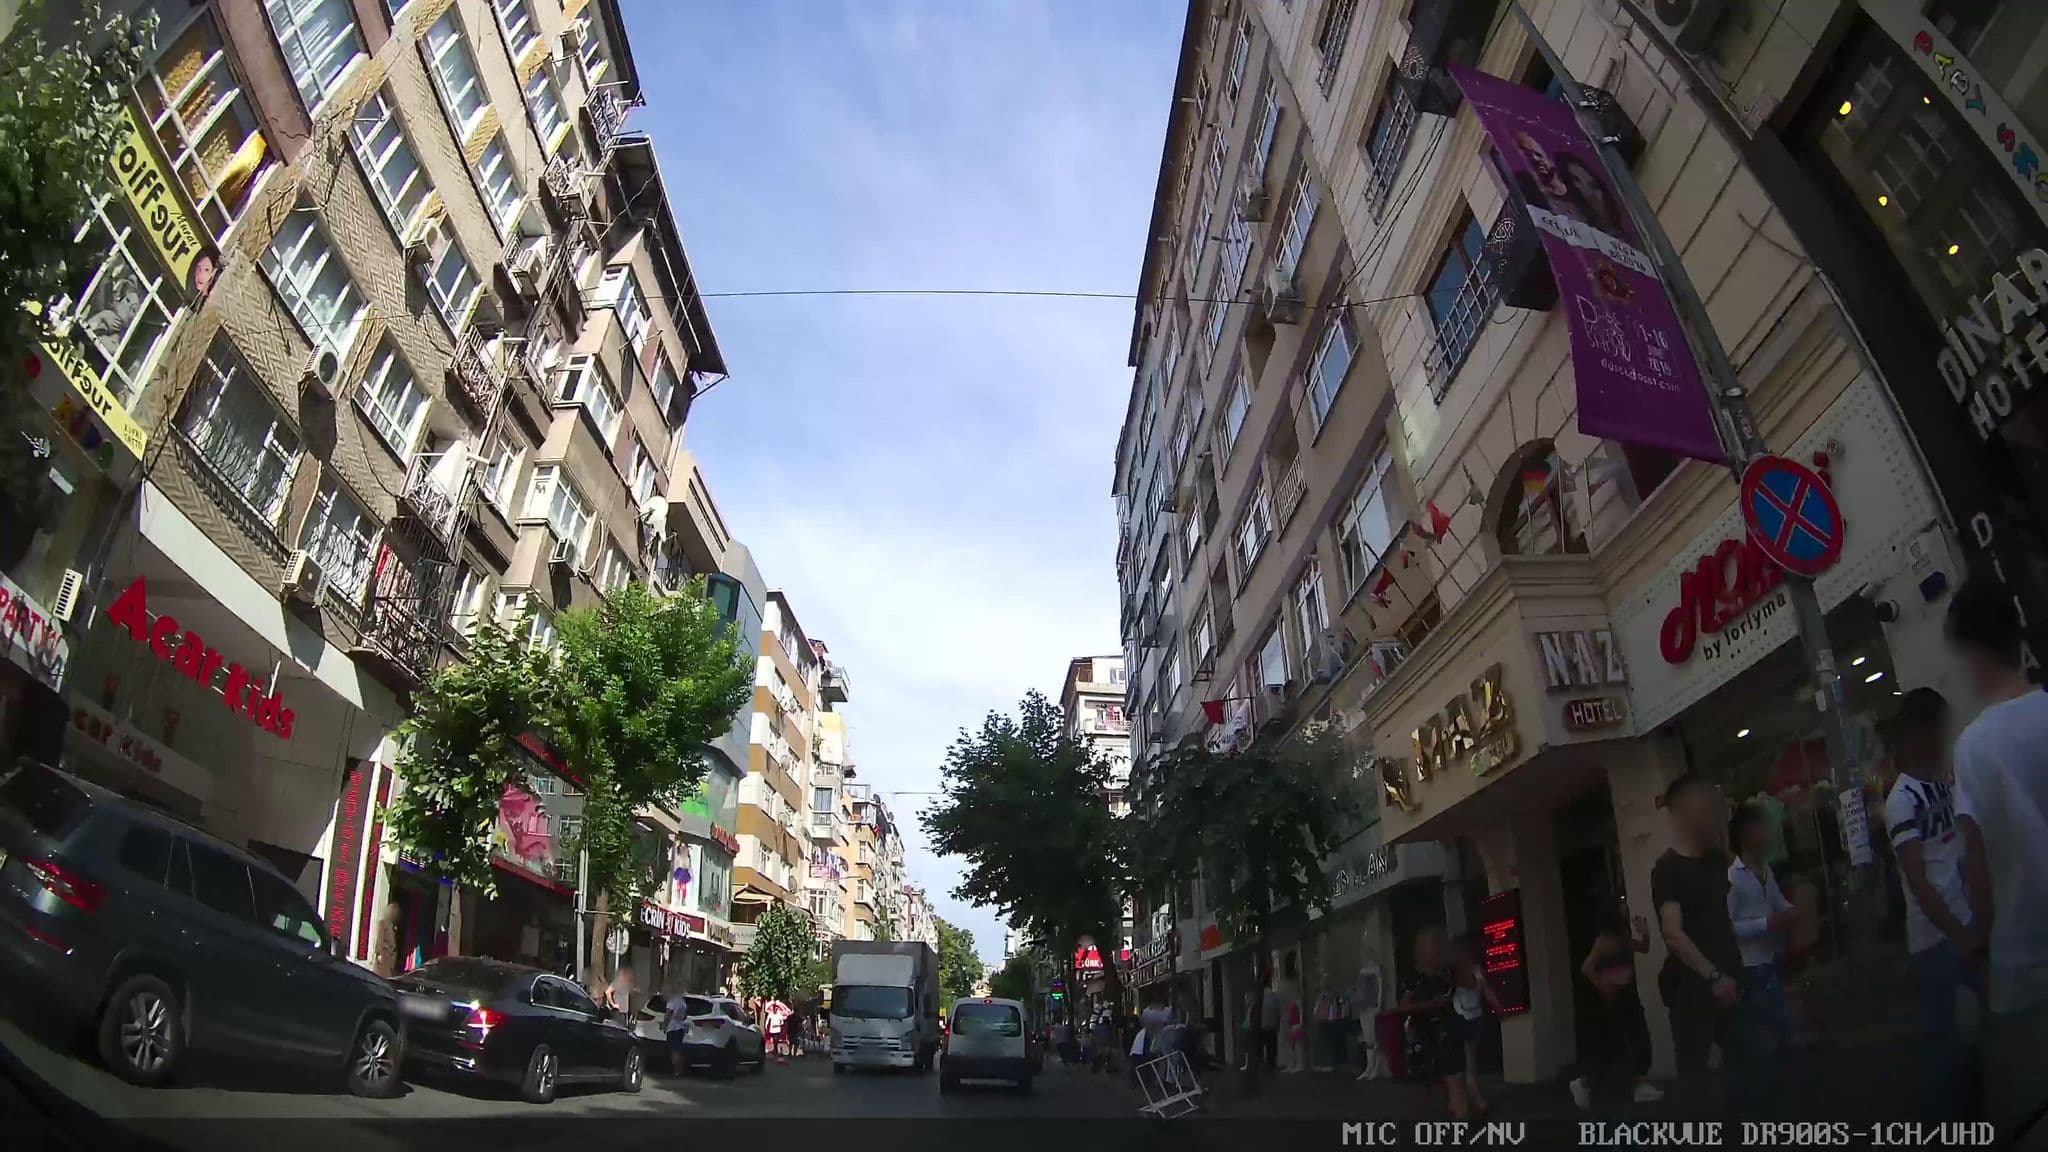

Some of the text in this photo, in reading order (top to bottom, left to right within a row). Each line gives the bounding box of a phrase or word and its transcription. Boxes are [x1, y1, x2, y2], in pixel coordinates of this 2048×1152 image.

[107, 574, 224, 690] Acar
[1537, 628, 1626, 688] NAZ
[1571, 699, 1623, 726] HOTEL
